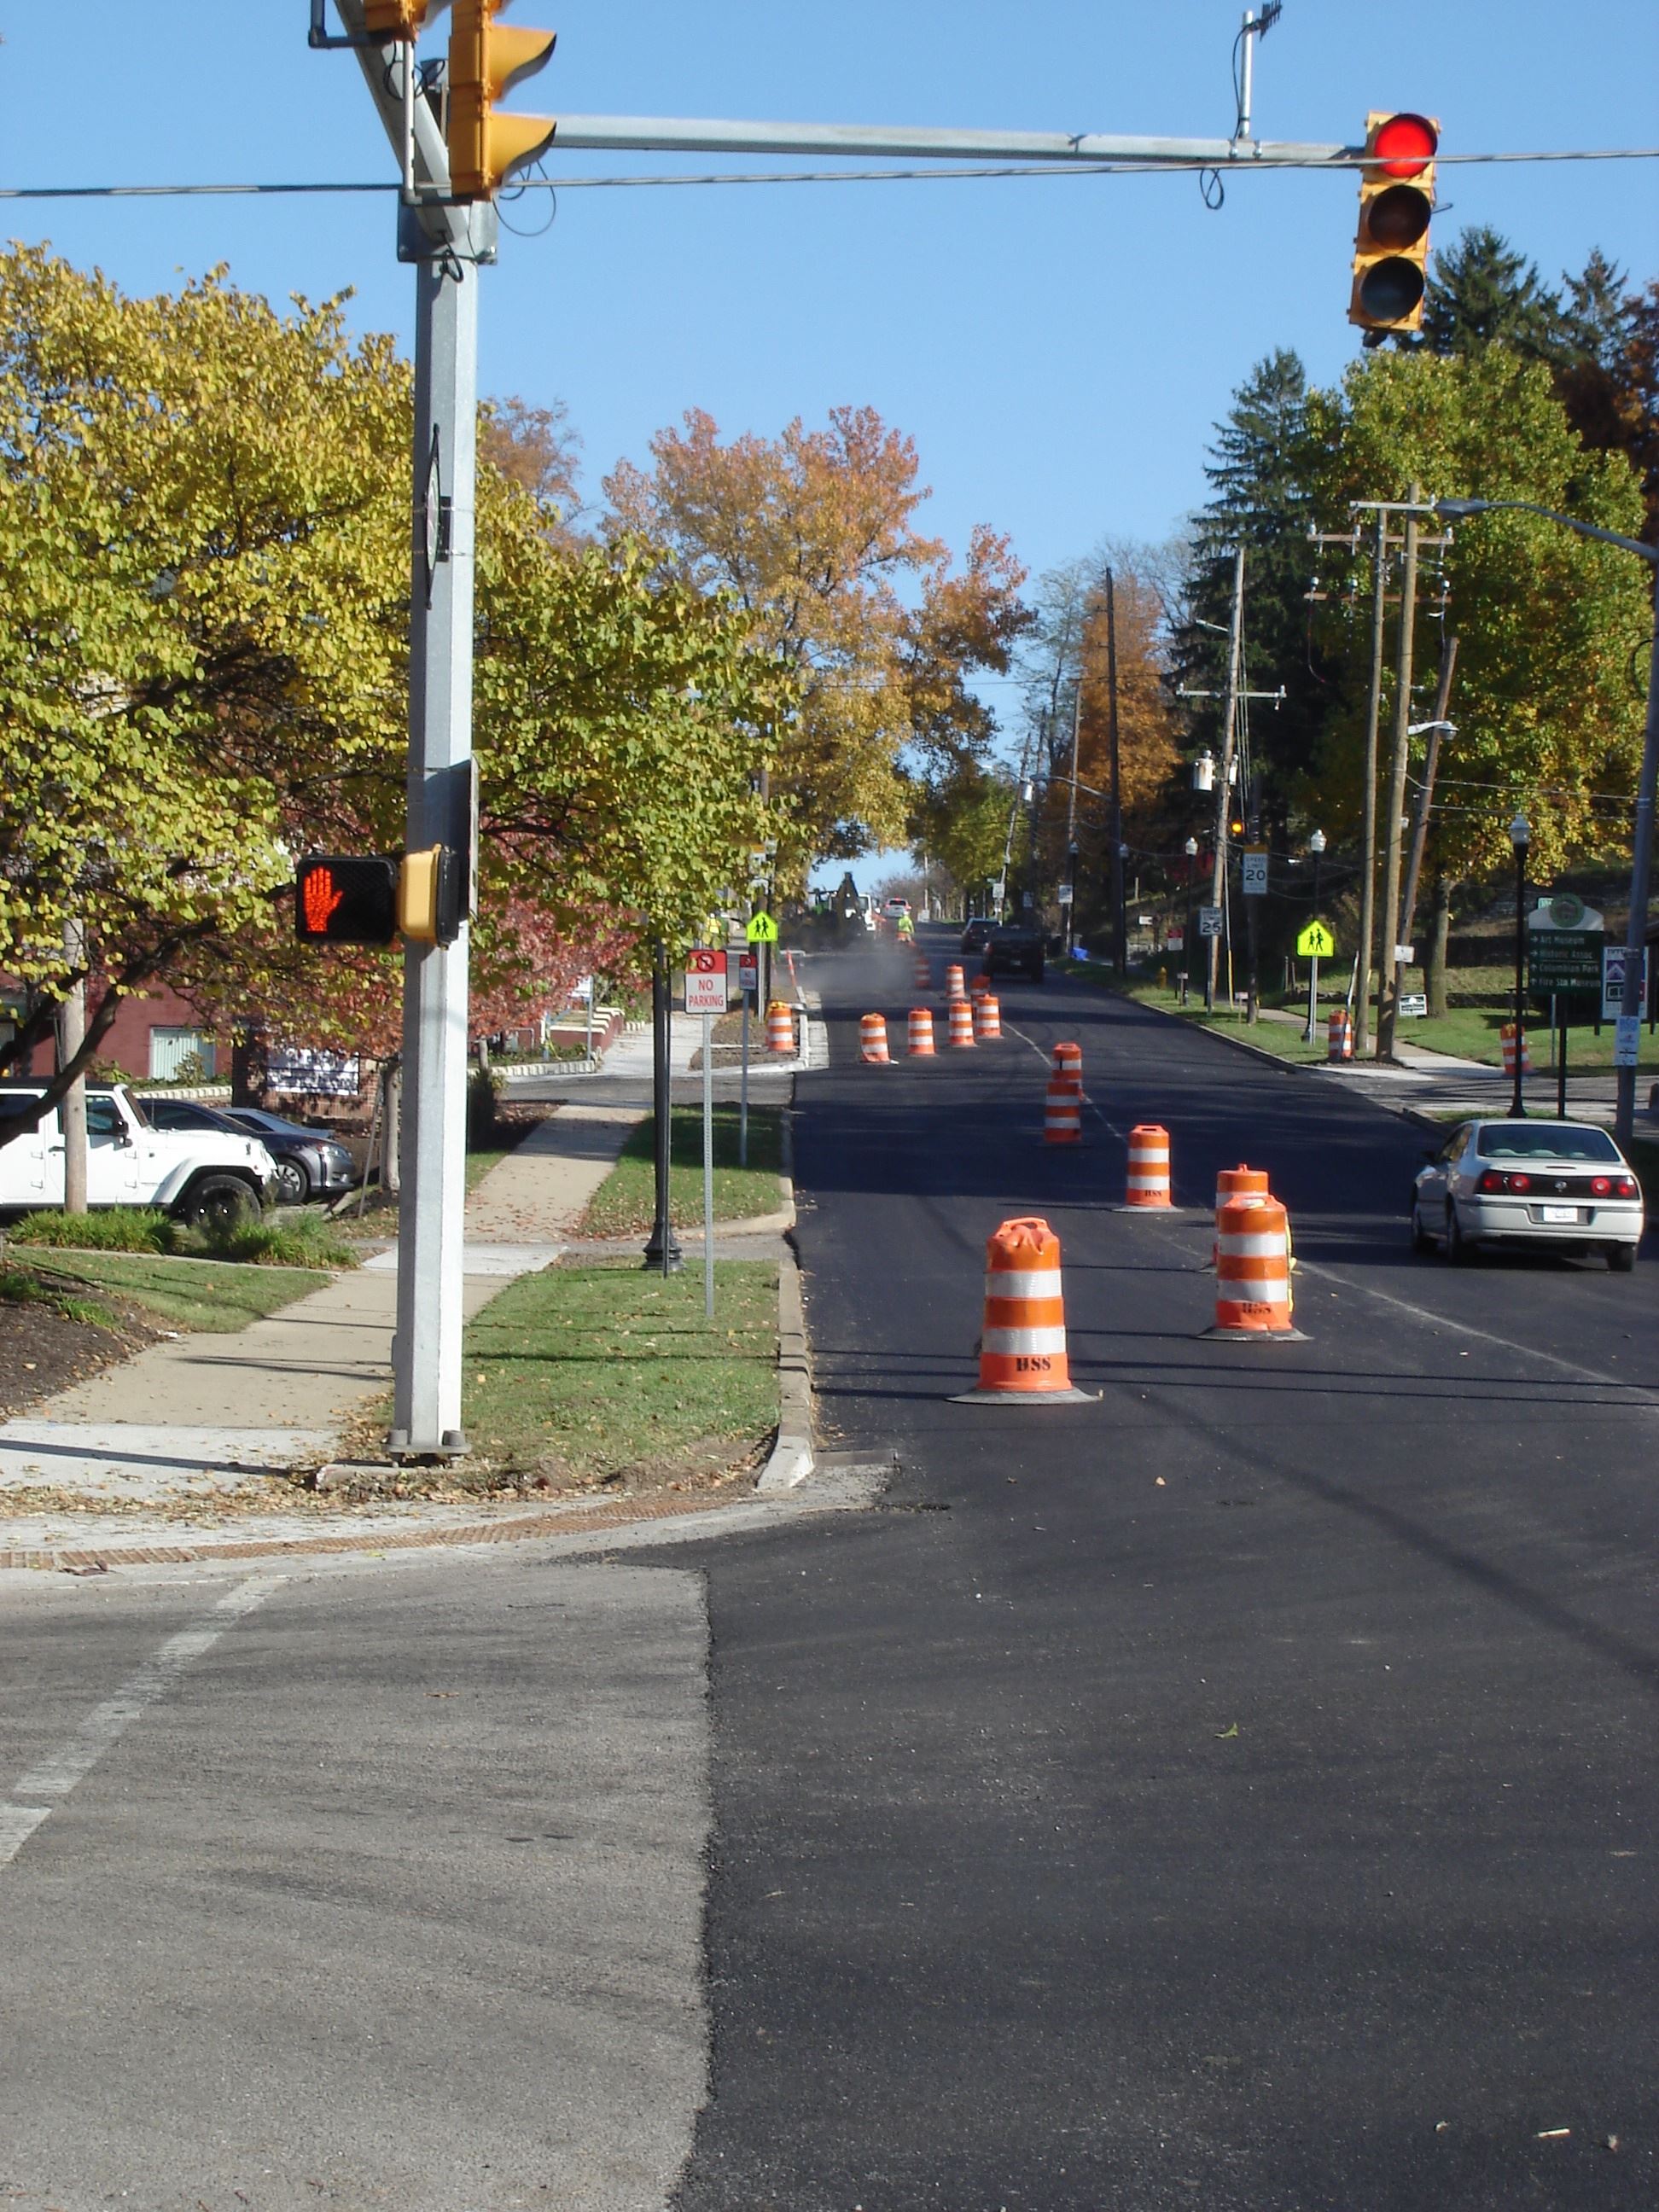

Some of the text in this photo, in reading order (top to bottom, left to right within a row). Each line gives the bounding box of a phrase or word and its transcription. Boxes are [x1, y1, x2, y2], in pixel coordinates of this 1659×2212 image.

[1245, 869, 1266, 881] 20
[1202, 922, 1221, 933] 25
[1554, 936, 1585, 945] Museum
[1582, 963, 1598, 973] Park
[698, 979, 713, 991] NO
[688, 995, 724, 1007] PARKING
